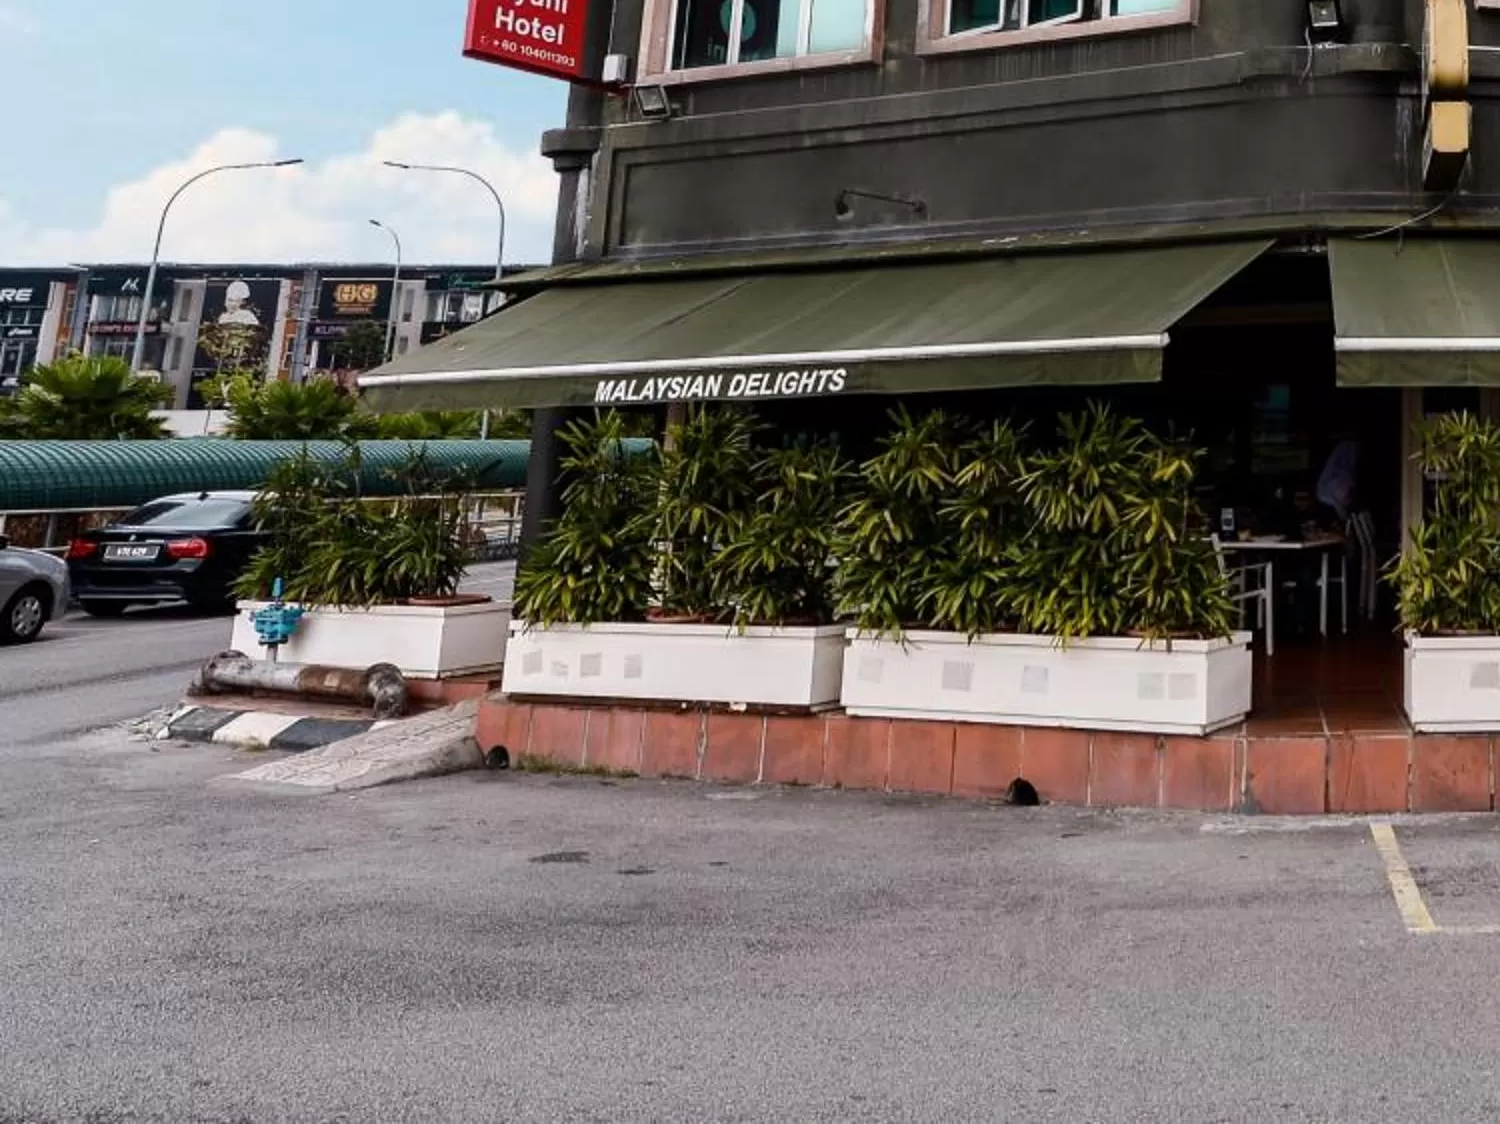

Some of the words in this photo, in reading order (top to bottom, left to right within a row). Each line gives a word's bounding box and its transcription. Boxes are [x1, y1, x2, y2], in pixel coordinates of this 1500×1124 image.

[495, 6, 565, 45] Hotel
[595, 374, 723, 402] MALAYSIAN
[728, 368, 848, 397] DELIGHTS
